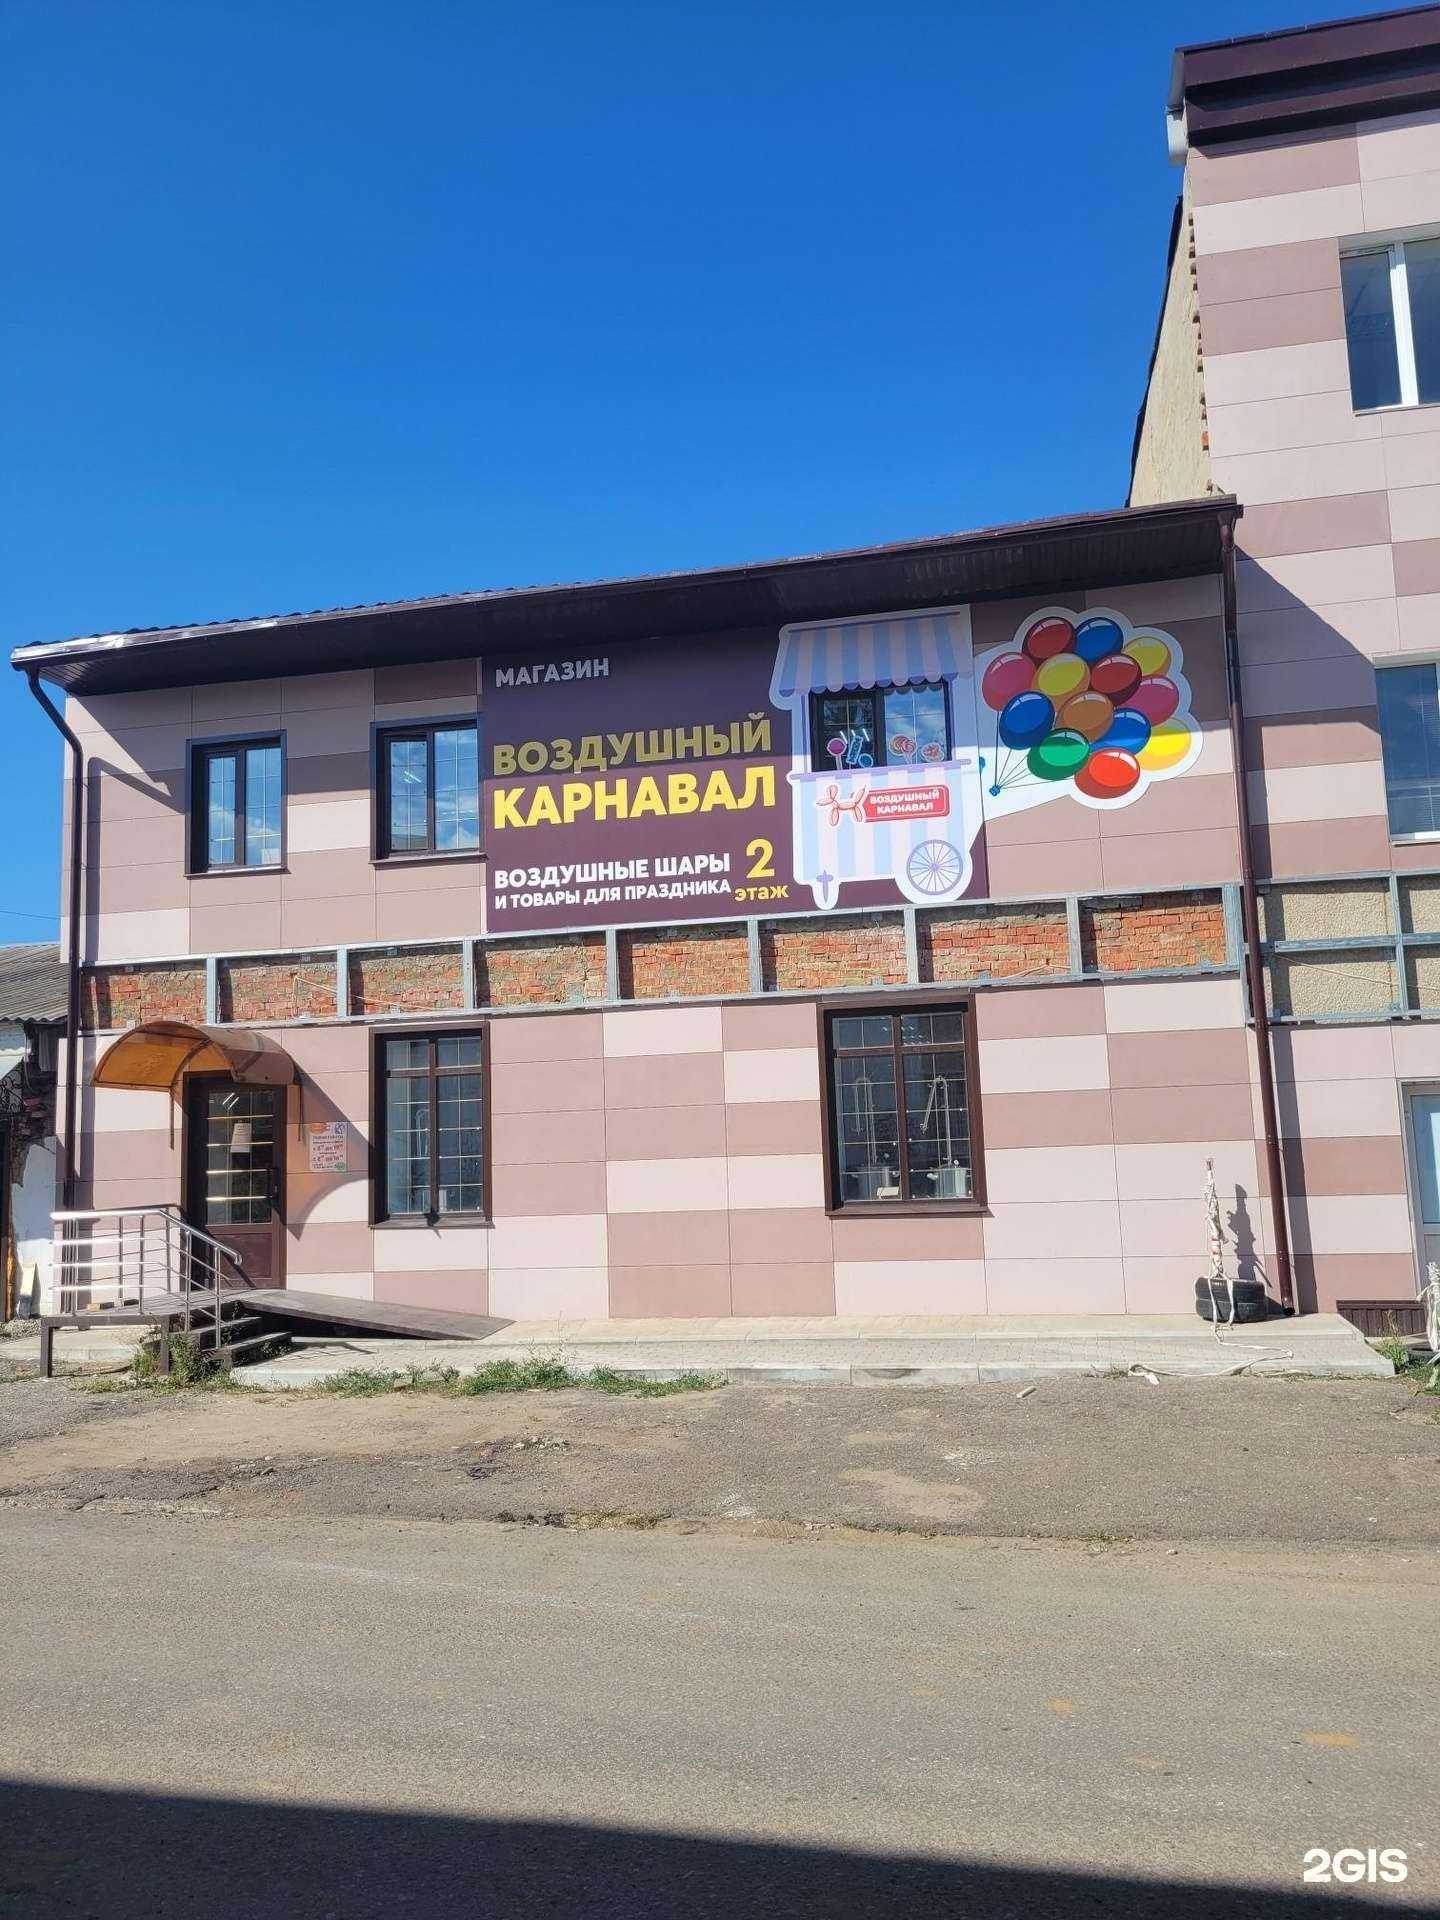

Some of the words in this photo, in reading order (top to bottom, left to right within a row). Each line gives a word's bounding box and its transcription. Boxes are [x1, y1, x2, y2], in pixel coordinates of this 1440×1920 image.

[495, 657, 610, 687] МАГАЗИН
[493, 711, 772, 776] ВОЗДУШНЫЙ
[493, 765, 776, 829] КАРНАВАЛ
[870, 789, 940, 805] ВОЗДУШНЫЙ
[876, 802, 934, 814] КАРНАВАЛ
[494, 859, 649, 889] ВОЗДУШНЫЕ
[654, 852, 730, 878] ШАРЫ
[745, 838, 775, 879] 2
[495, 893, 507, 909] И
[511, 888, 580, 908] ТОВАРЫ
[583, 886, 621, 905] ДЛЯ
[625, 878, 732, 900] ПРАЗДНИКА
[734, 883, 790, 902] этаж
